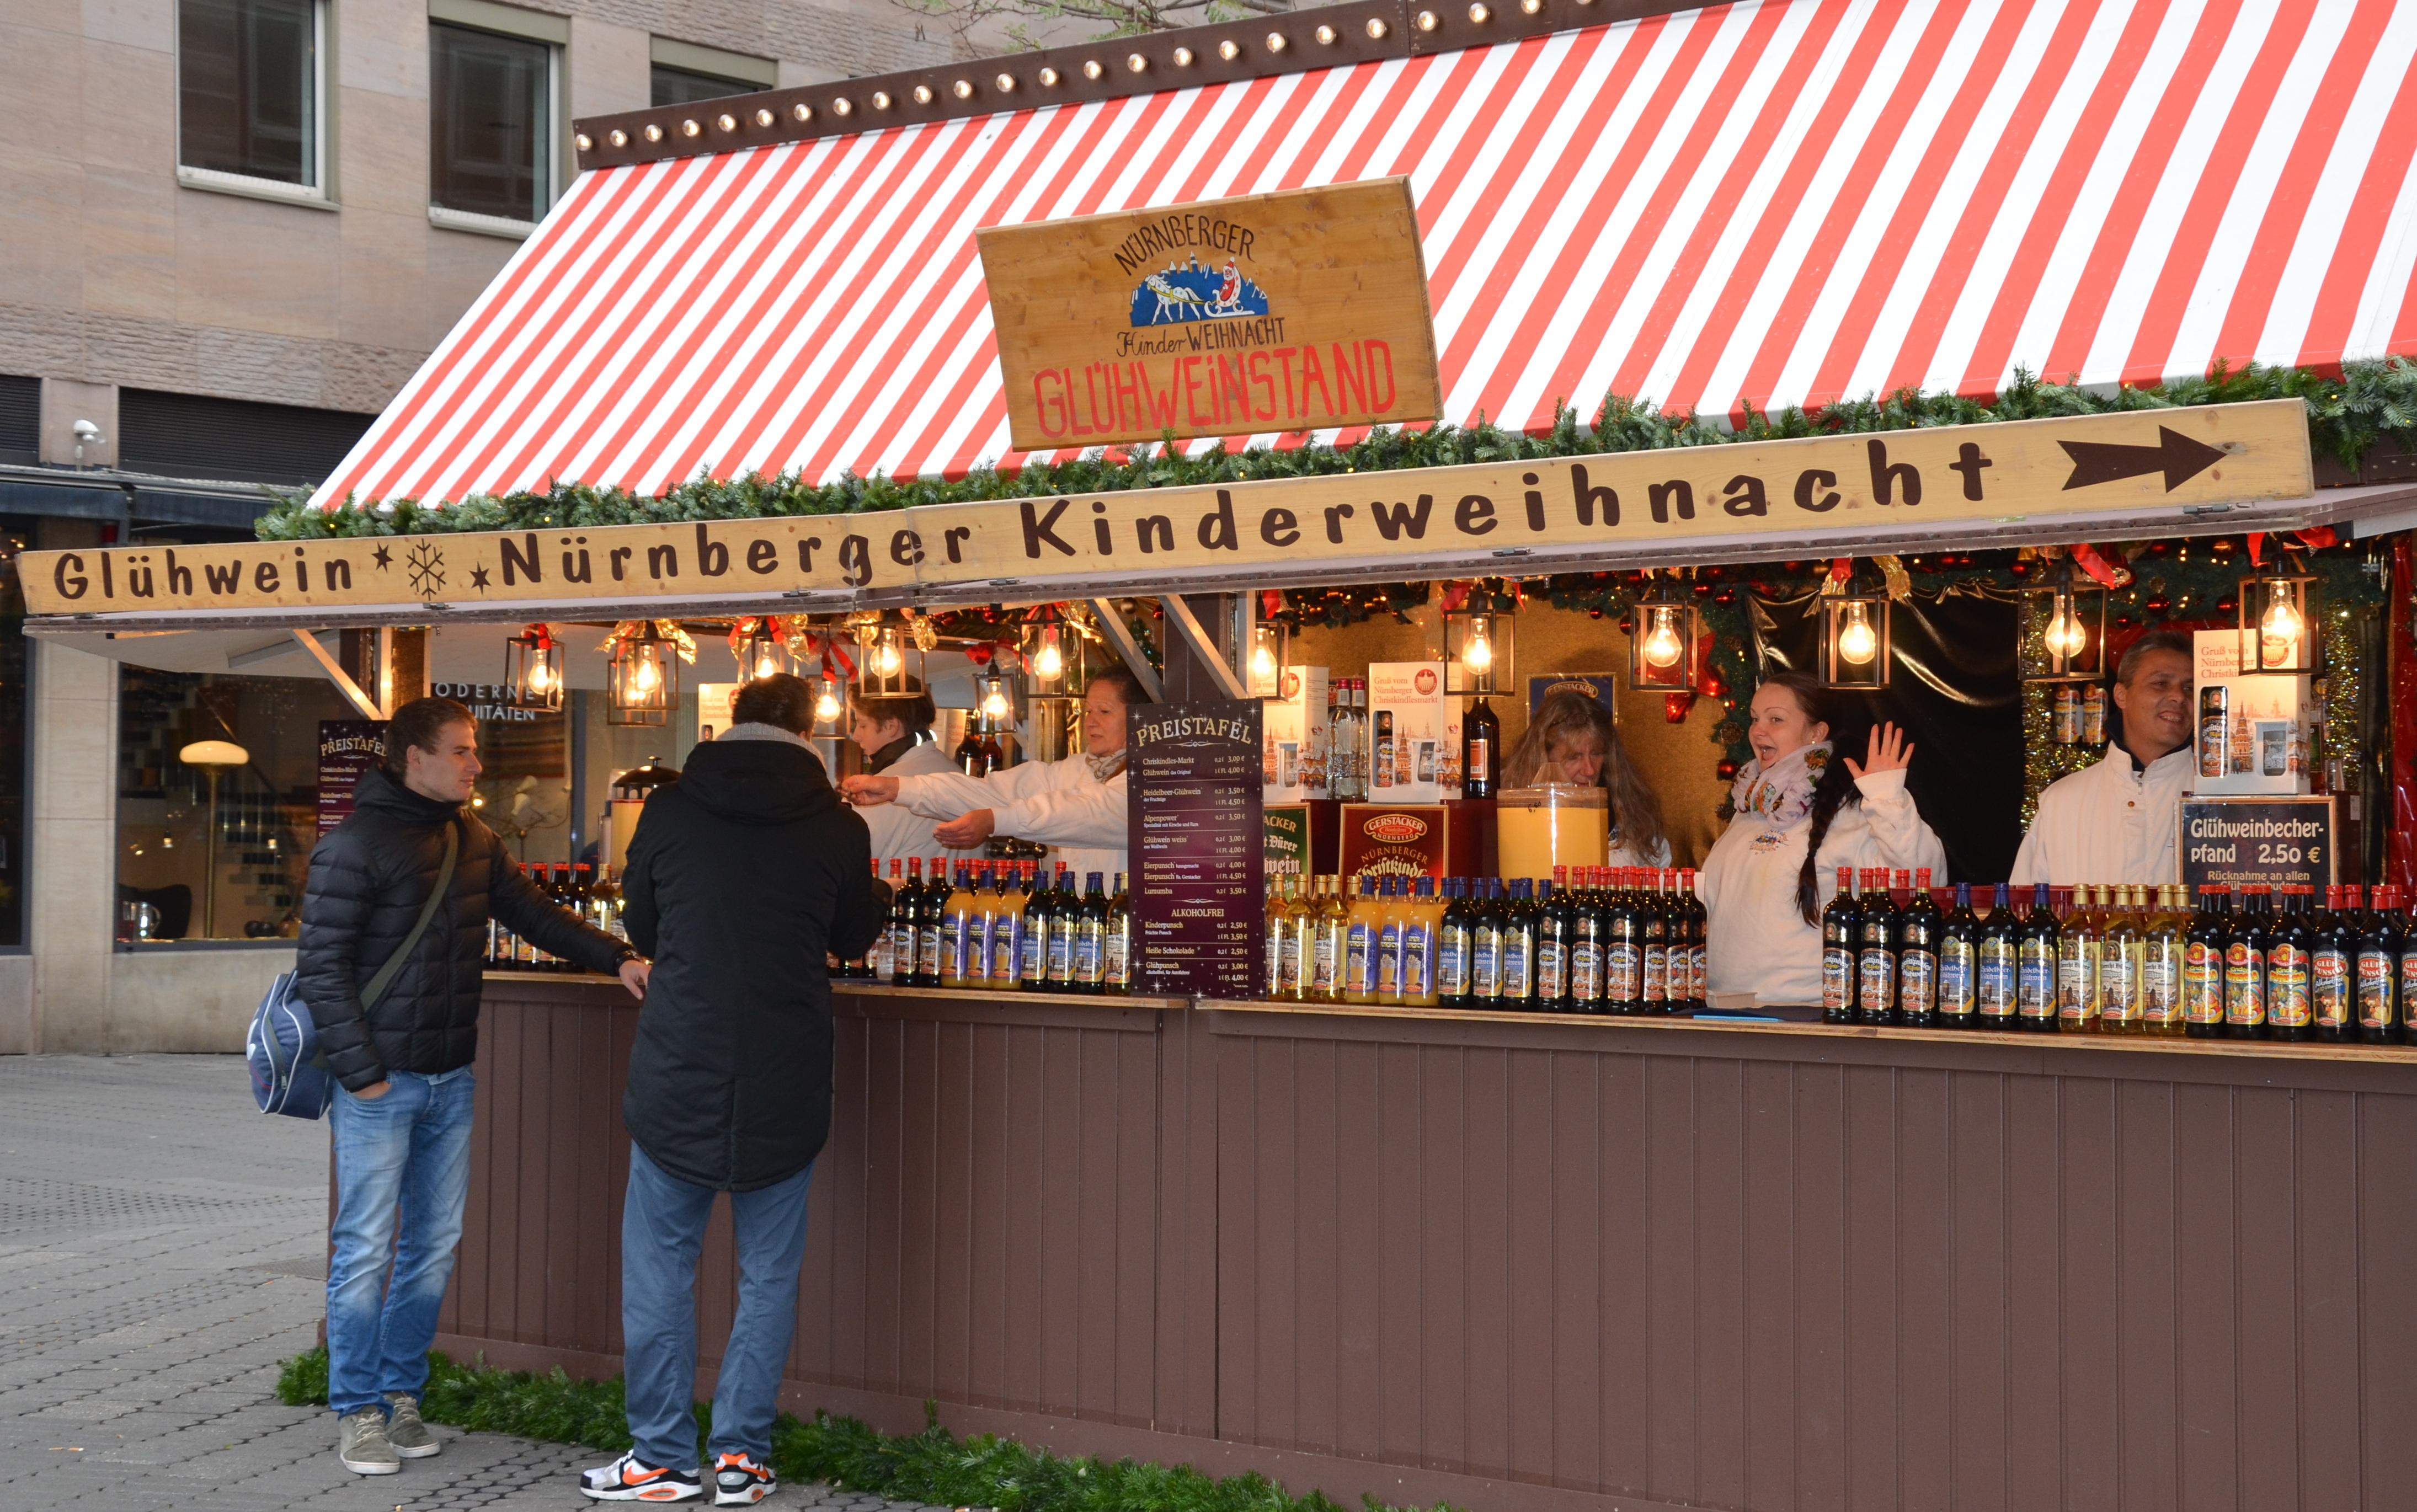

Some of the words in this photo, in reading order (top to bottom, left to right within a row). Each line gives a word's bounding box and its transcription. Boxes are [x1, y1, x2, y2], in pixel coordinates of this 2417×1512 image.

[1114, 214, 1256, 276] NÜRNBERGER
[1117, 332, 1187, 357] Kinder
[1185, 317, 1285, 352] WEIHNACHT
[54, 547, 351, 600] Glühwein
[500, 523, 970, 587] Nürnberger
[1020, 439, 1992, 558] Kinderweihnacht
[1374, 687, 1412, 696] Nürnberger
[1137, 717, 1251, 747] PREISTAFEL
[321, 738, 387, 756] PREISTAFEL
[1264, 815, 1296, 832] ACKER
[1369, 816, 1423, 831] GERSTACKER
[2191, 818, 2324, 838] Glühweinbecher-
[1269, 835, 1298, 852] Dürer
[1361, 846, 1428, 864] NÜRNBERGER
[2191, 843, 2235, 863] pfand
[2258, 844, 2301, 864] 2,50
[2307, 847, 2320, 863] €
[1144, 862, 1175, 870] Eierpunsch
[1144, 873, 1175, 881] Eierpunsch
[2208, 871, 2266, 880] Rücknahme
[2286, 871, 2309, 880] allen
[1171, 909, 1224, 917] ALKOHOLFREI
